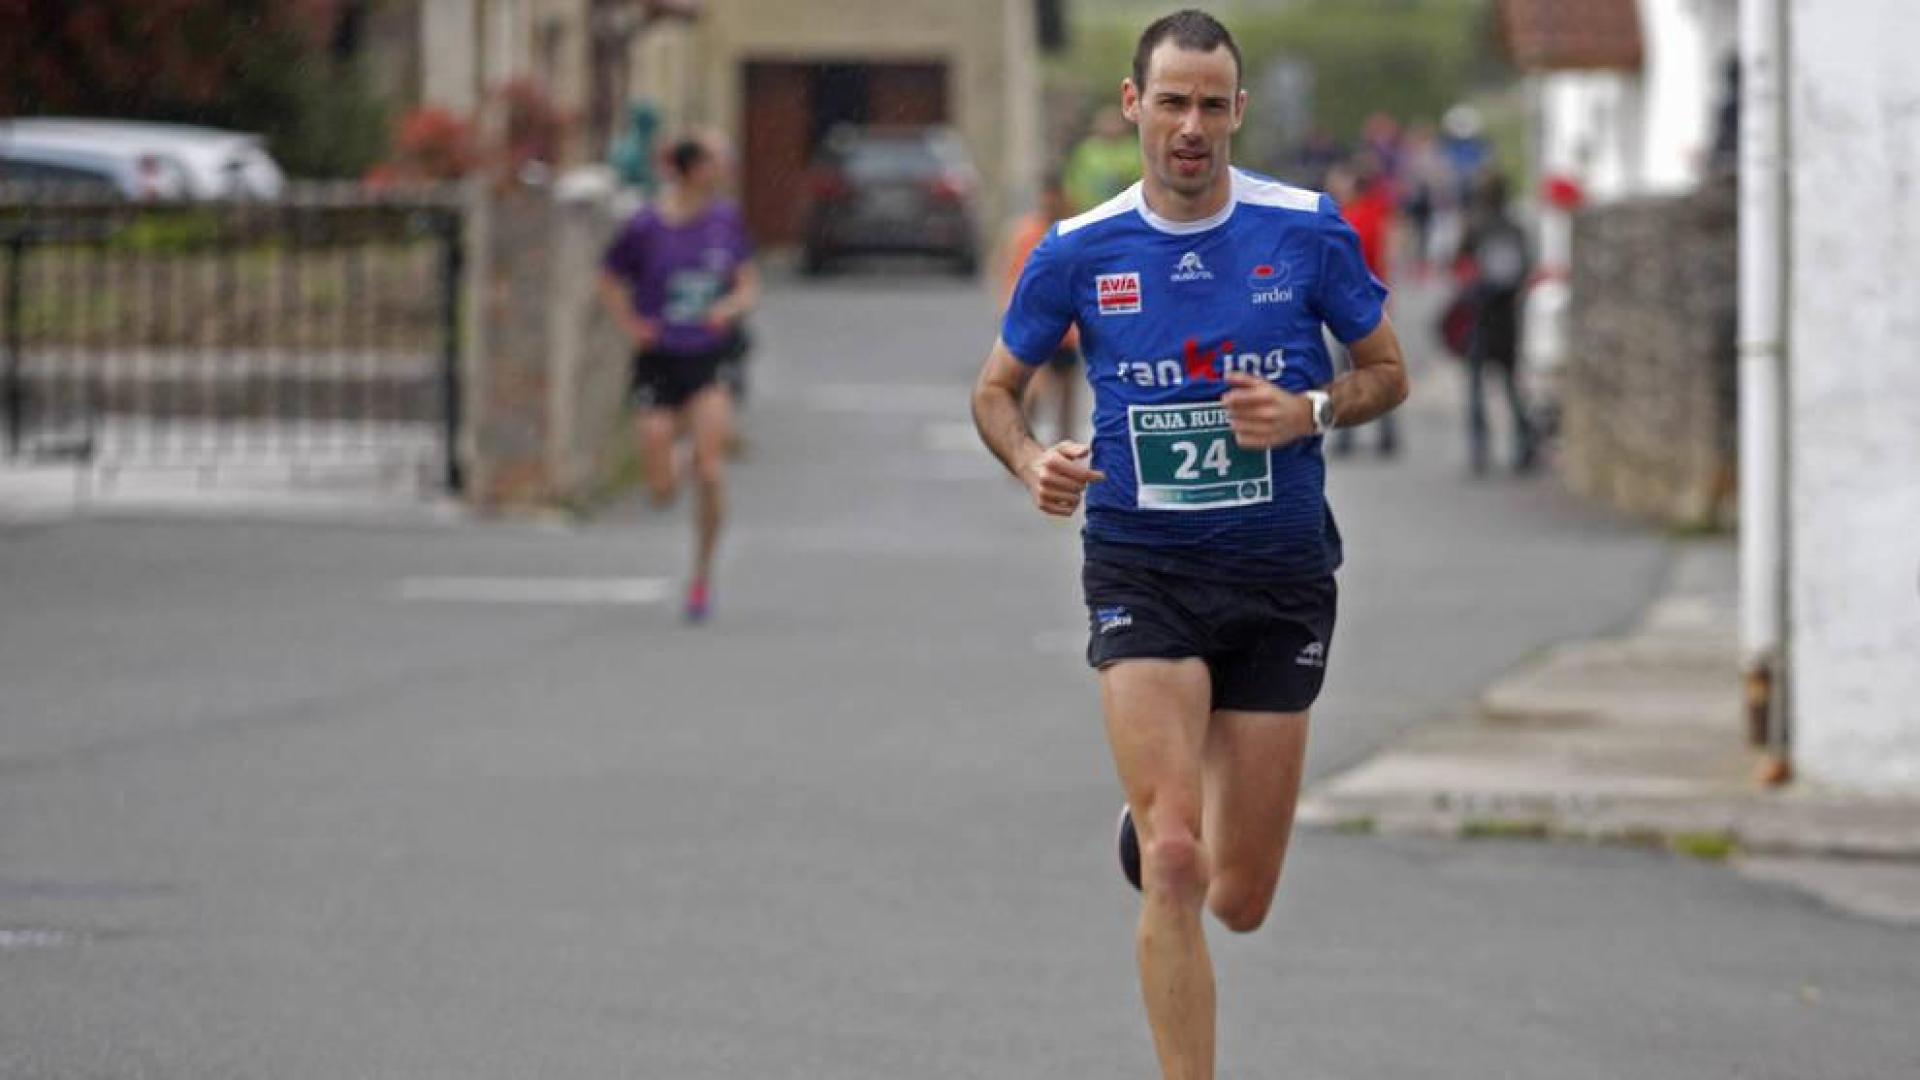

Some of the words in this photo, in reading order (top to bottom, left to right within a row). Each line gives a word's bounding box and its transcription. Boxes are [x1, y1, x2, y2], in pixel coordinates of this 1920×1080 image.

[1101, 278, 1137, 292] AVIA
[1141, 411, 1186, 429] CAJA
[1171, 438, 1231, 480] 24
